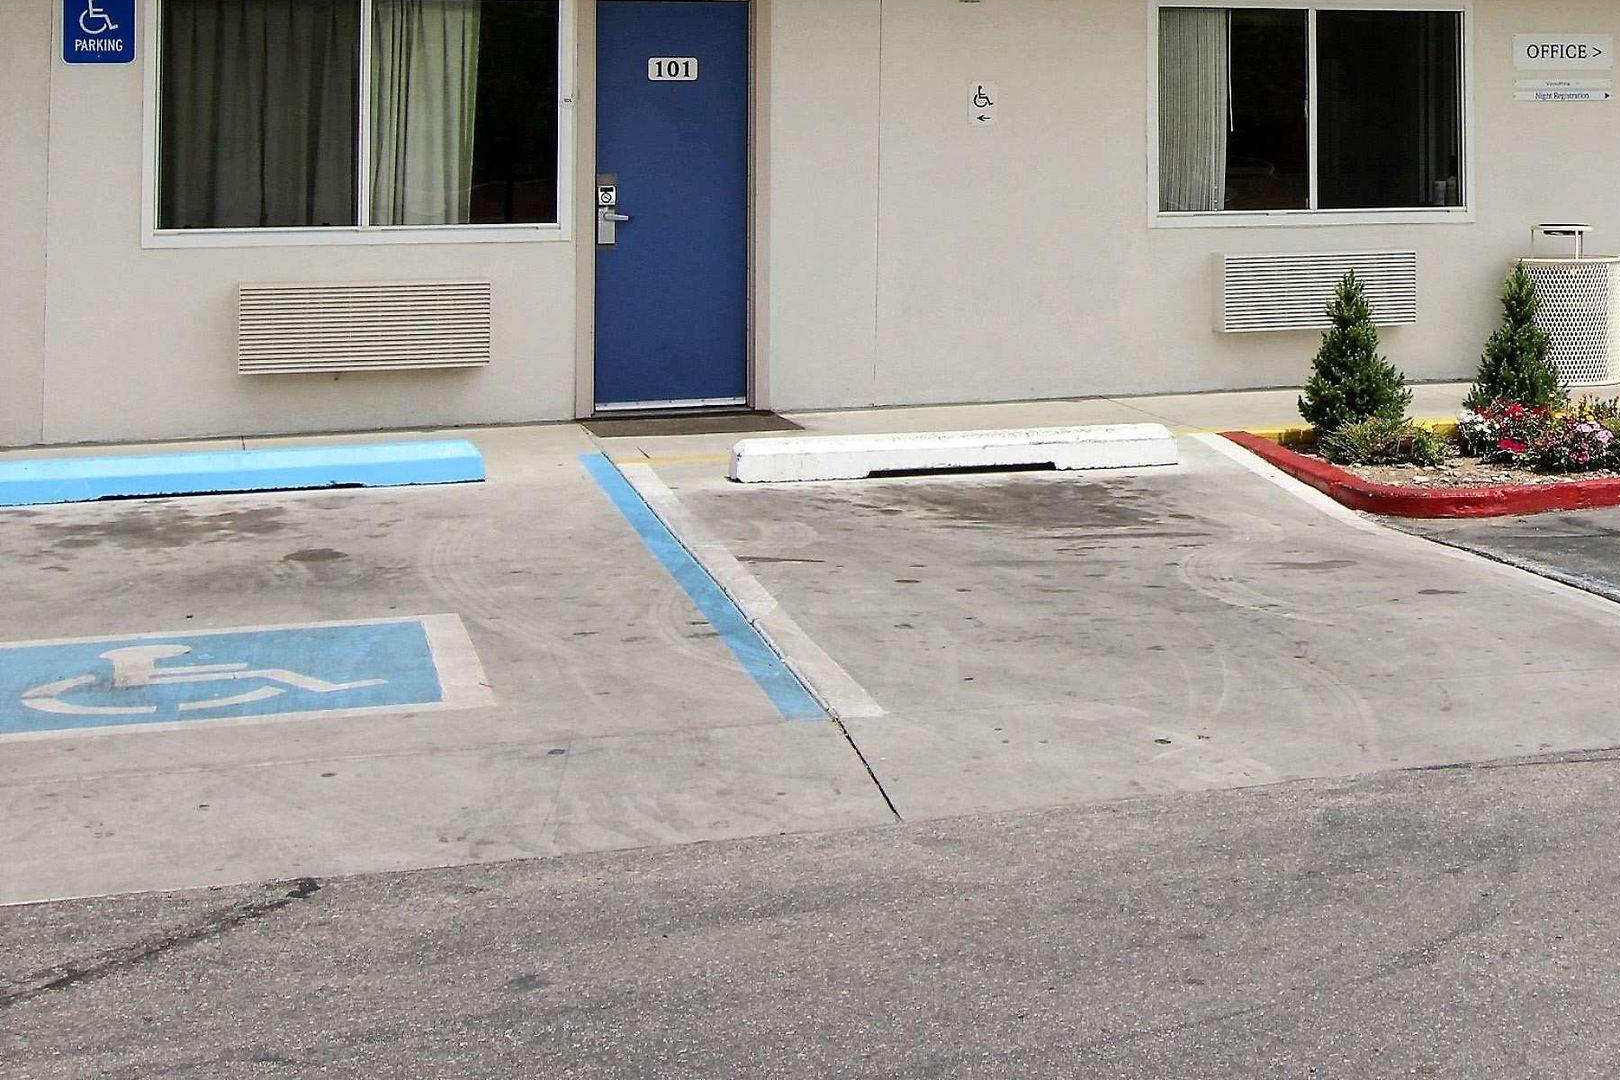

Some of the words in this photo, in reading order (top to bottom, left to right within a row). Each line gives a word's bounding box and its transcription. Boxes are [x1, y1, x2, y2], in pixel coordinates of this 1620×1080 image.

[74, 39, 123, 52] PARKING
[1526, 44, 1587, 59] OFFICE
[655, 60, 690, 77] 101
